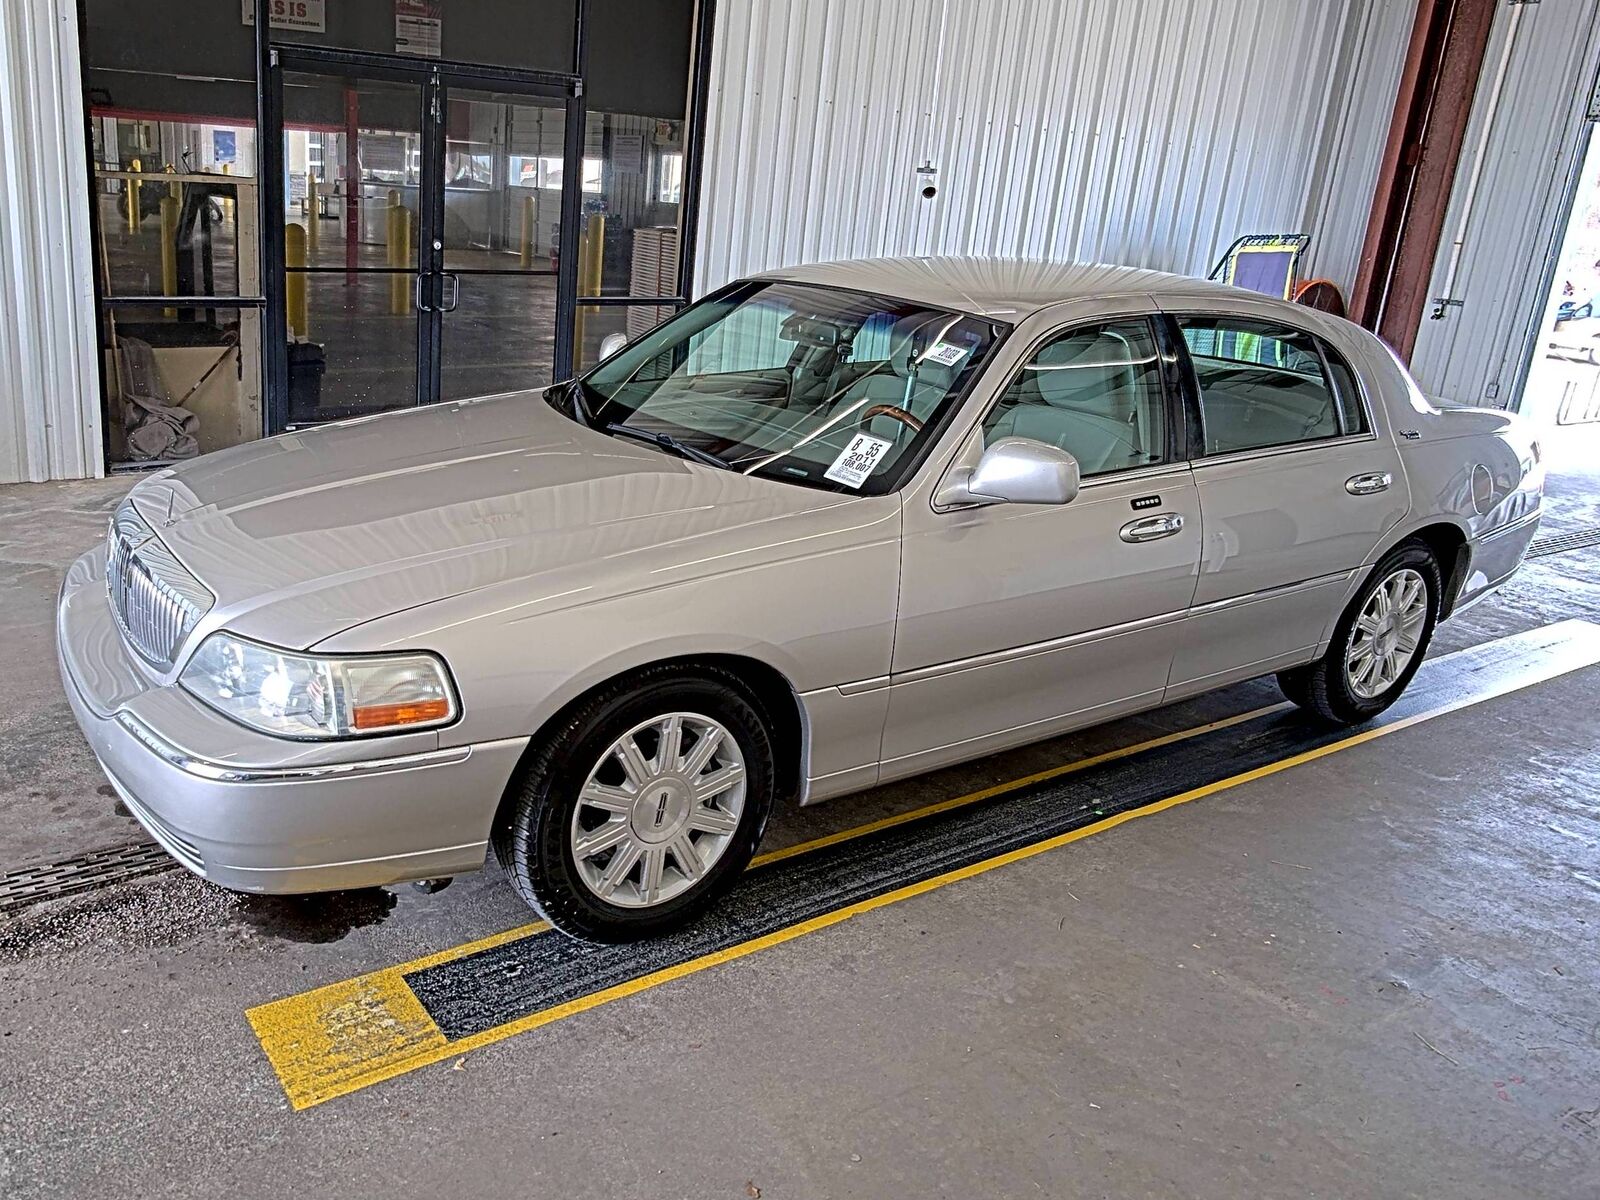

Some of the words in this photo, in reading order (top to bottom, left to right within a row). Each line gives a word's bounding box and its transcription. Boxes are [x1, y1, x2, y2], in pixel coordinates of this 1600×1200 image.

[289, 2, 307, 17] IS
[851, 438, 864, 451] B
[865, 442, 883, 458] 55
[848, 451, 876, 466] 2011
